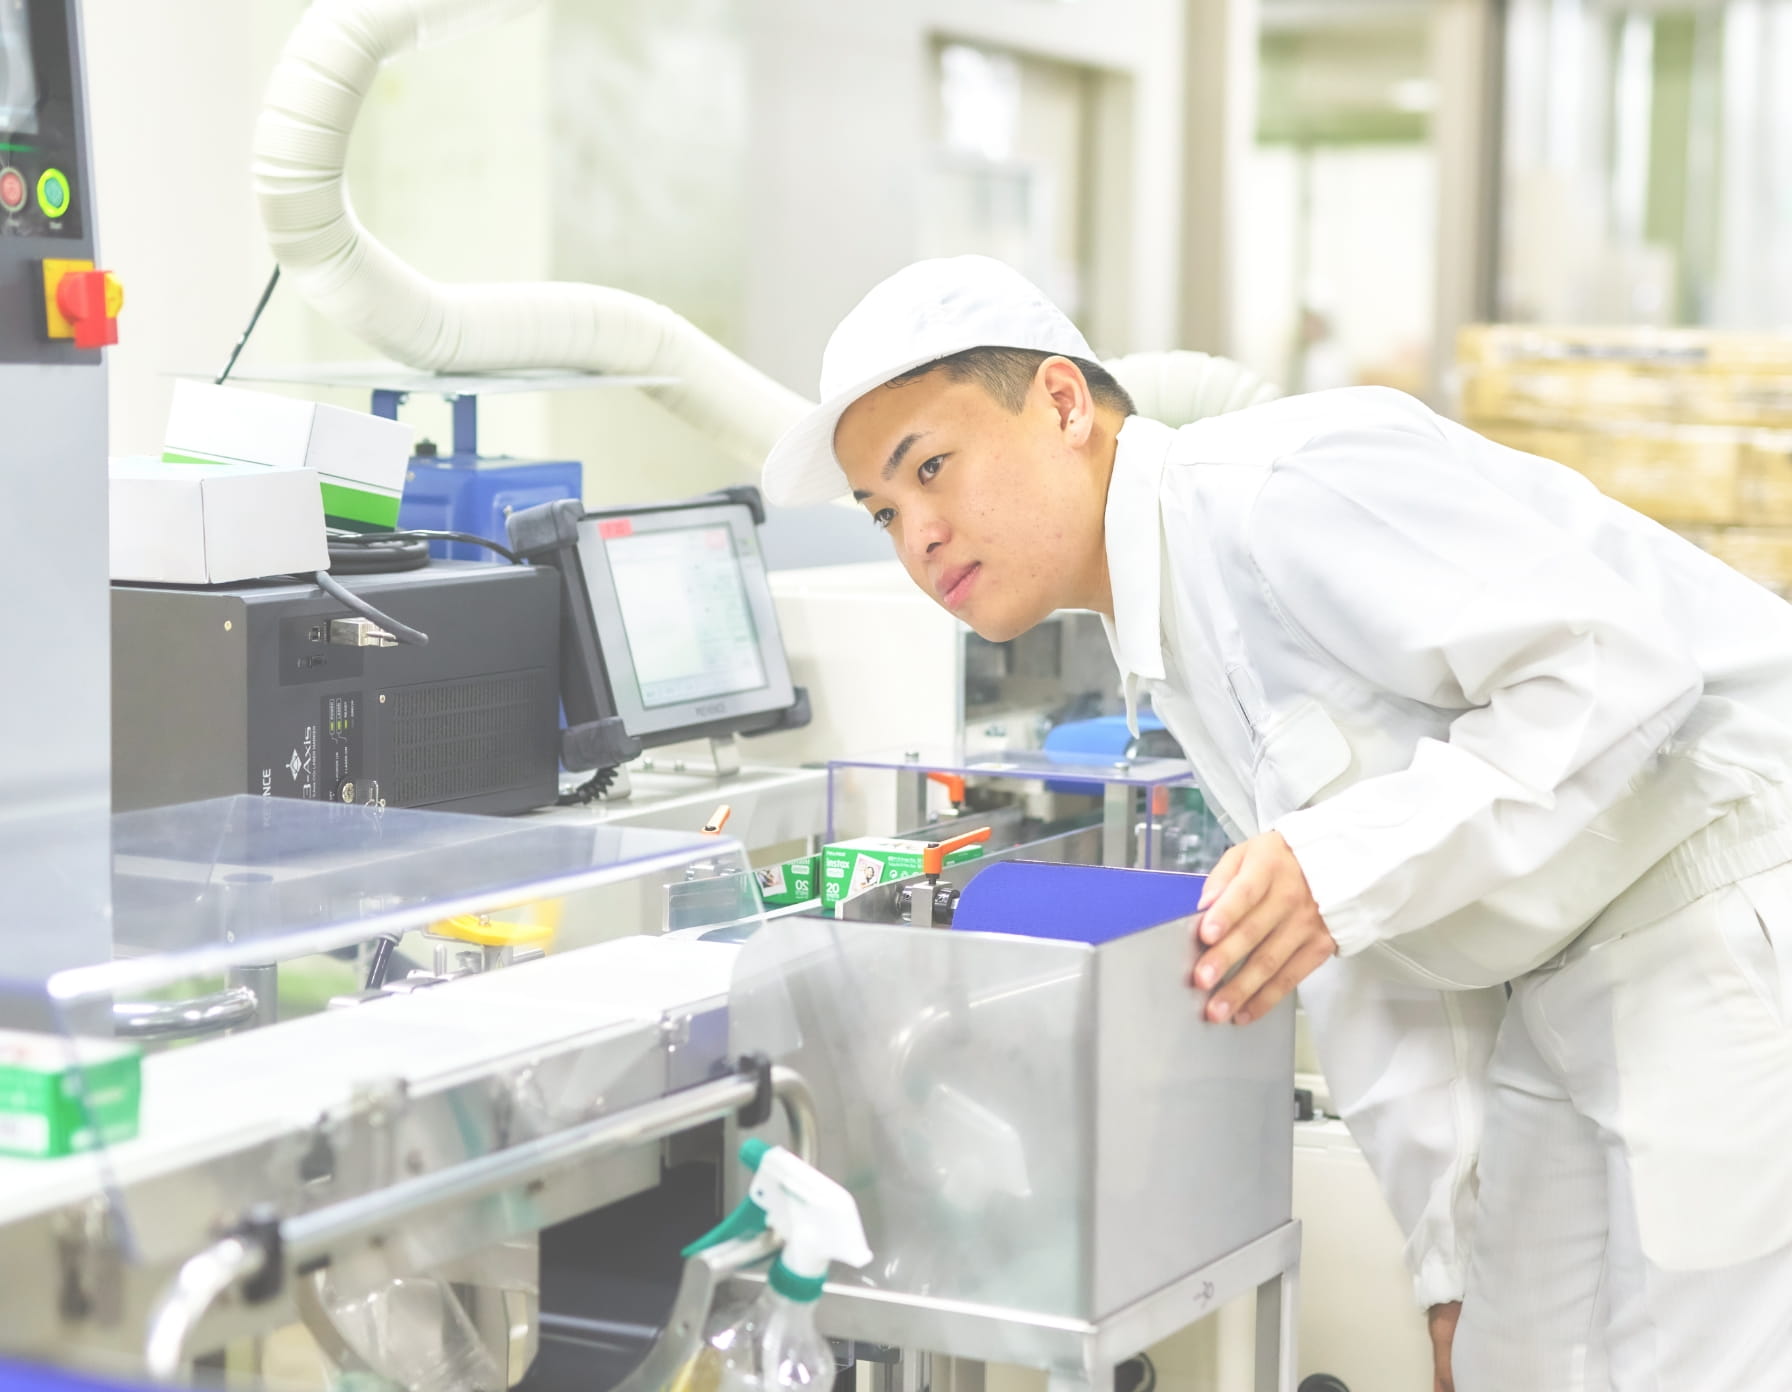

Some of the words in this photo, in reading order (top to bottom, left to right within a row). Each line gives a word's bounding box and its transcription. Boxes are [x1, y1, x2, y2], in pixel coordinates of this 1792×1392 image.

[302, 726, 312, 799] 3-Axis
[262, 768, 271, 828] KENCE
[826, 882, 840, 894] 20
